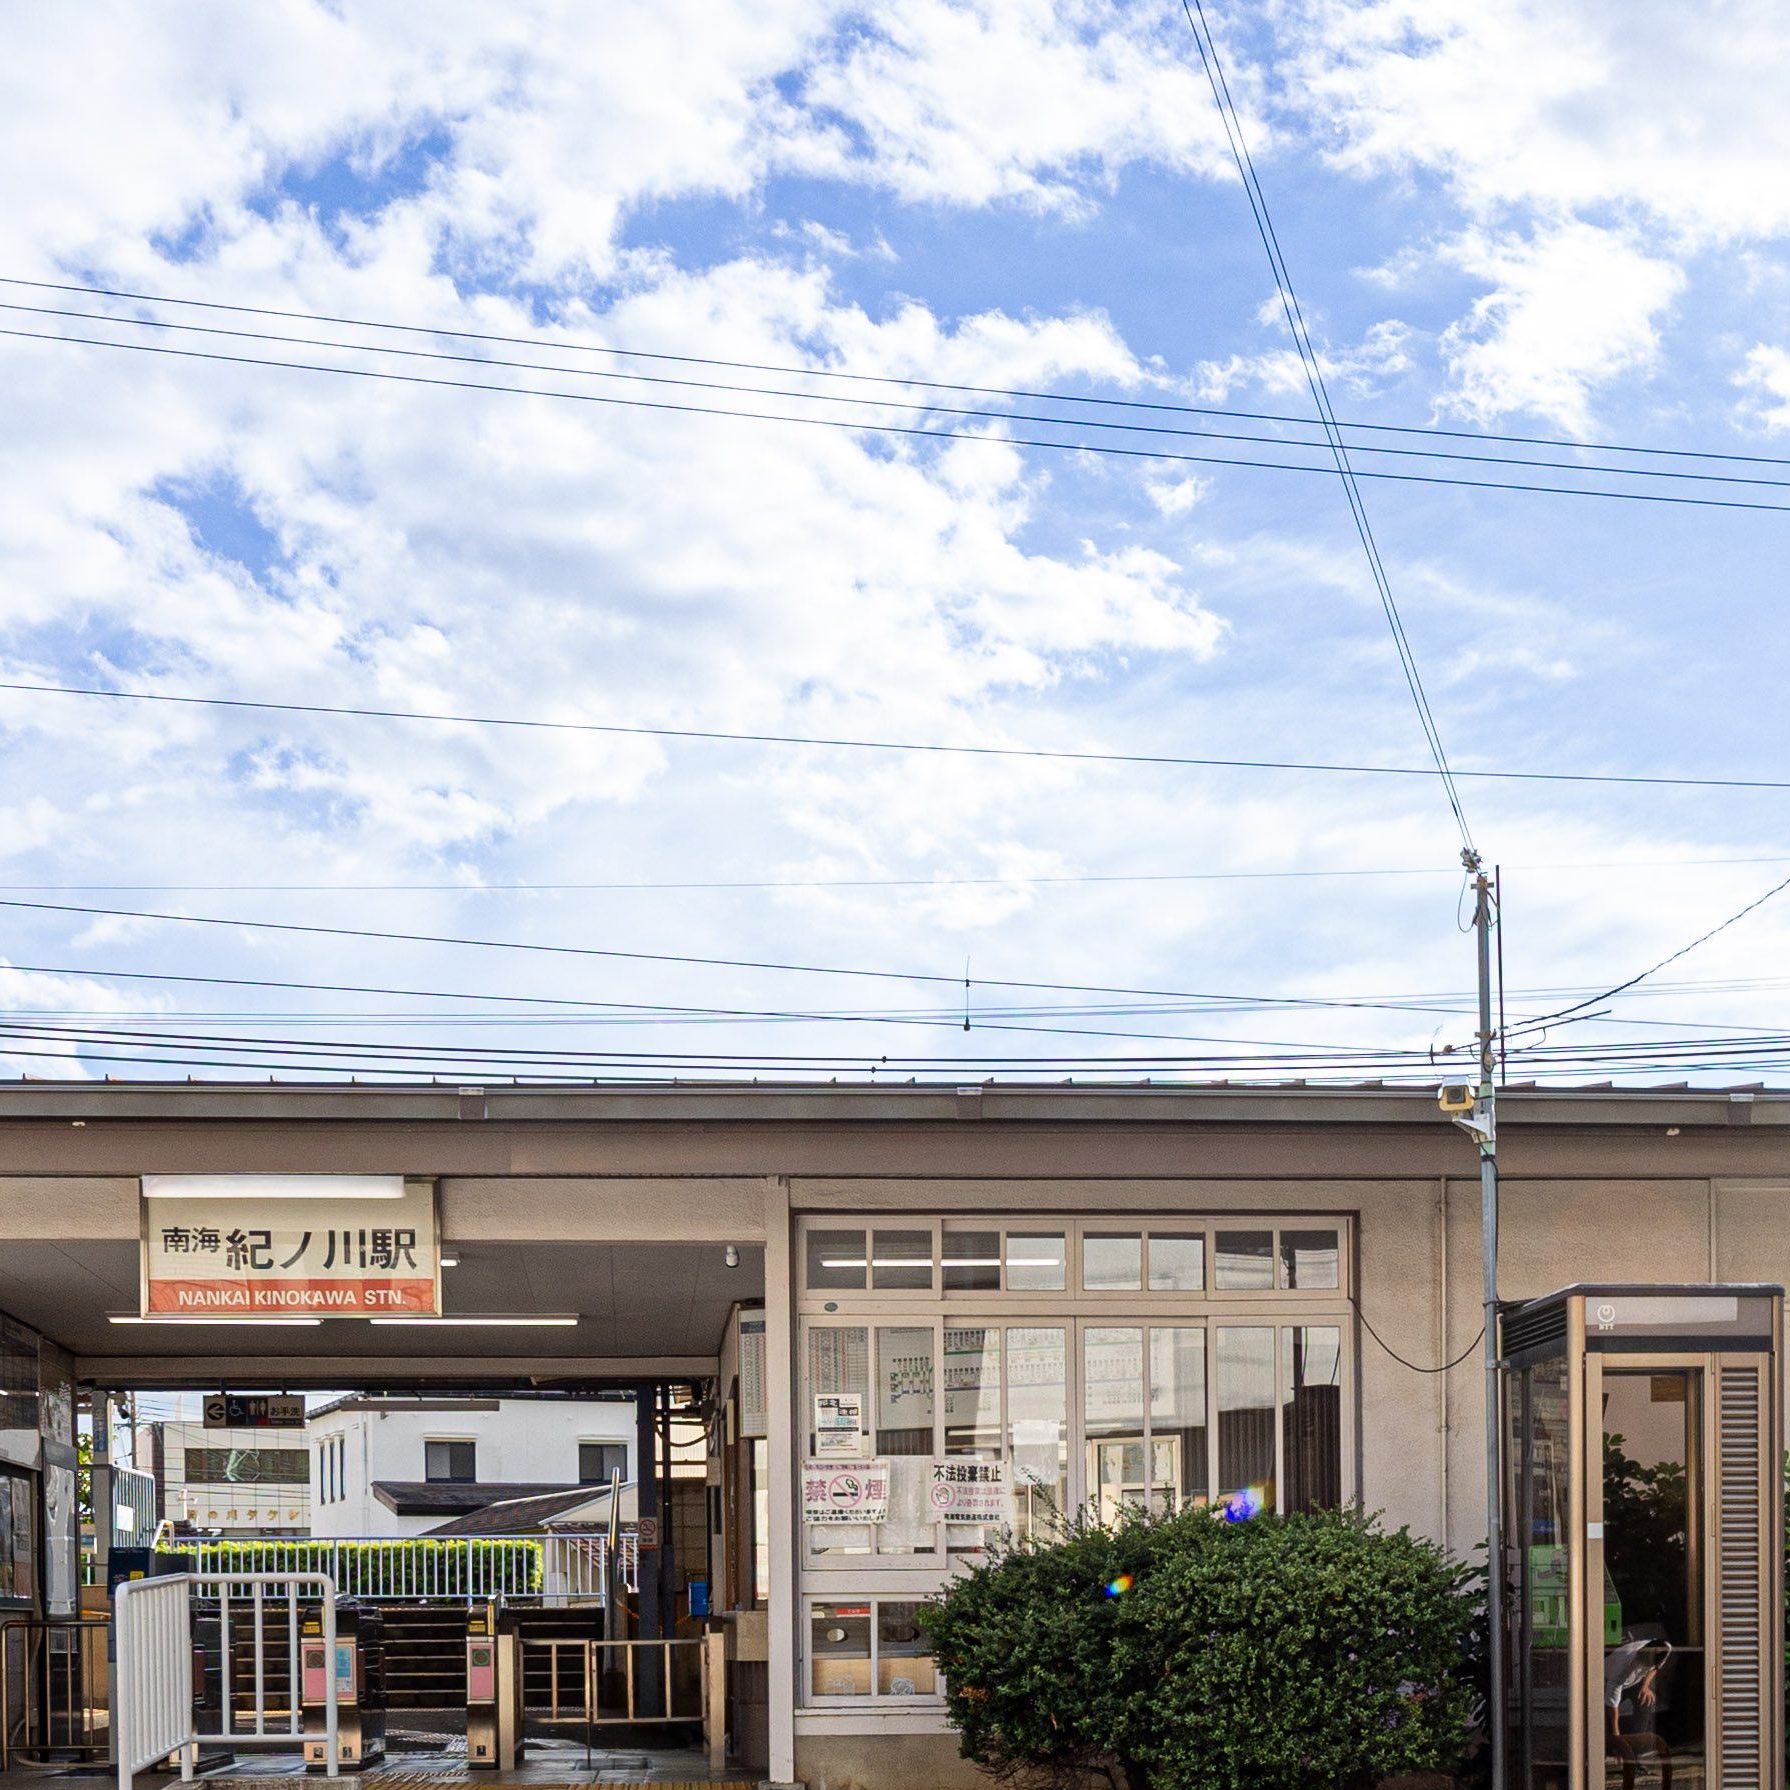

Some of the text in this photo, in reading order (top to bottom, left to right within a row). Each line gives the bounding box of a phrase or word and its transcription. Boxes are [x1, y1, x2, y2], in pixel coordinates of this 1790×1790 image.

[161, 1227, 220, 1253] 南海
[179, 1290, 407, 1306] NANKAI KINOKAWA STN.
